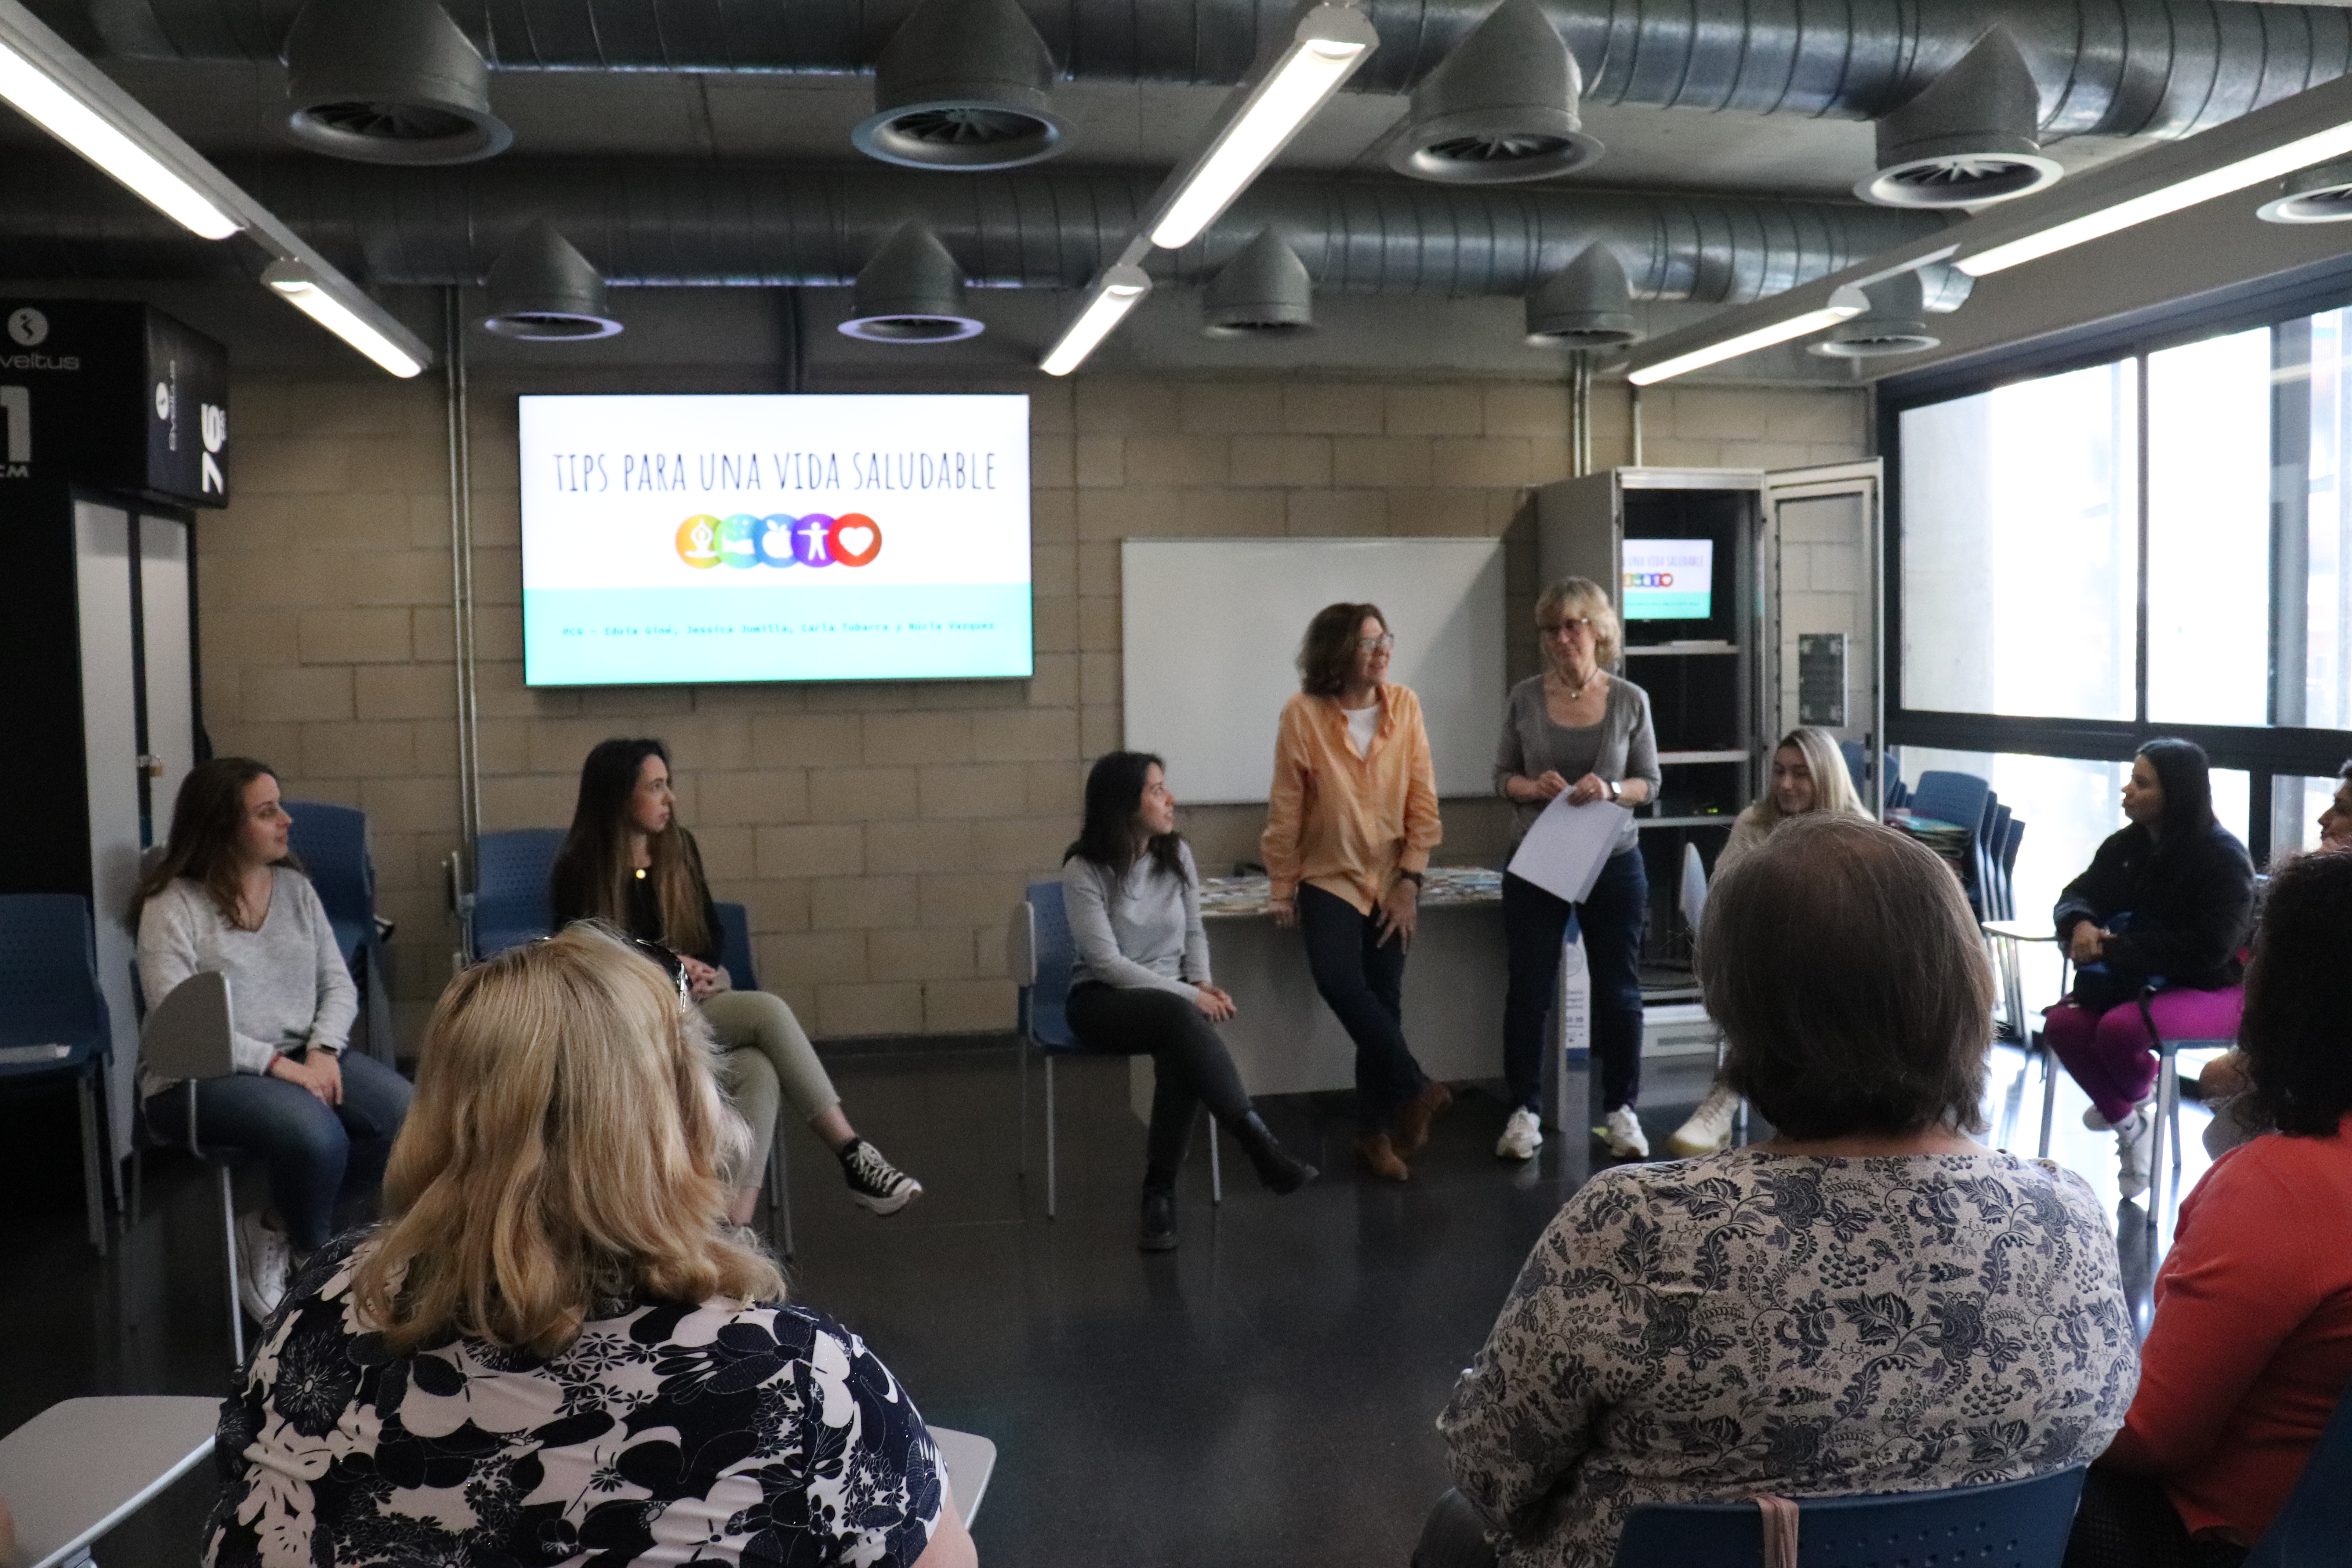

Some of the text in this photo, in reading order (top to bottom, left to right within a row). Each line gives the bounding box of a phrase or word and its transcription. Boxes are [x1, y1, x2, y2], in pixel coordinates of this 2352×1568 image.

[0, 352, 79, 371] veltus
[553, 452, 996, 492] TIPS PARA UNA VIDA SALUDABLE
[687, 624, 733, 633] Jessica
[801, 622, 835, 632] Carla
[895, 624, 901, 633] y
